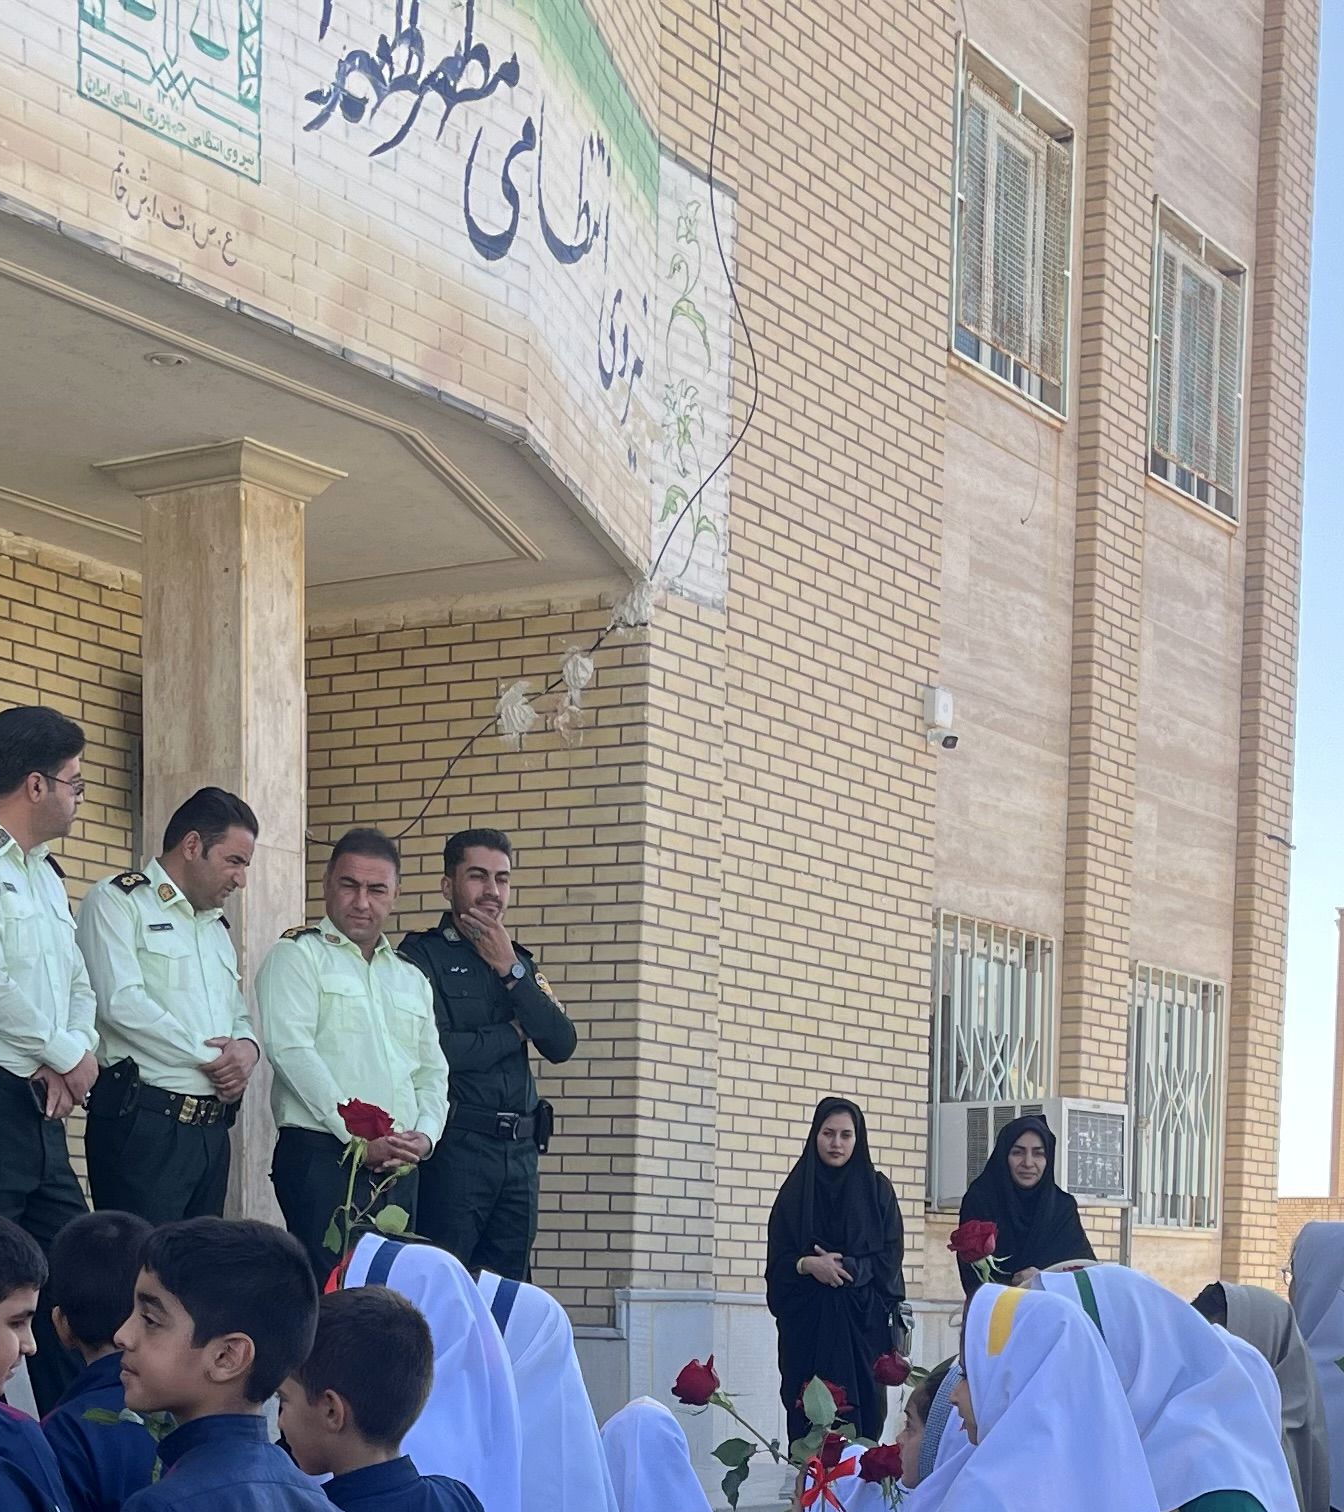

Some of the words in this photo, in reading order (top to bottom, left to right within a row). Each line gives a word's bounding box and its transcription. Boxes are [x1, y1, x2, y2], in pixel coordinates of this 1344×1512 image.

[85, 76, 111, 103] ایران
[111, 89, 142, 113] اسلامی
[143, 105, 187, 133] جمهوری
[187, 129, 224, 153] انتظامی
[223, 147, 256, 172] نیروی
[464, 95, 612, 275] انتظامی
[597, 284, 649, 474] نیروی
